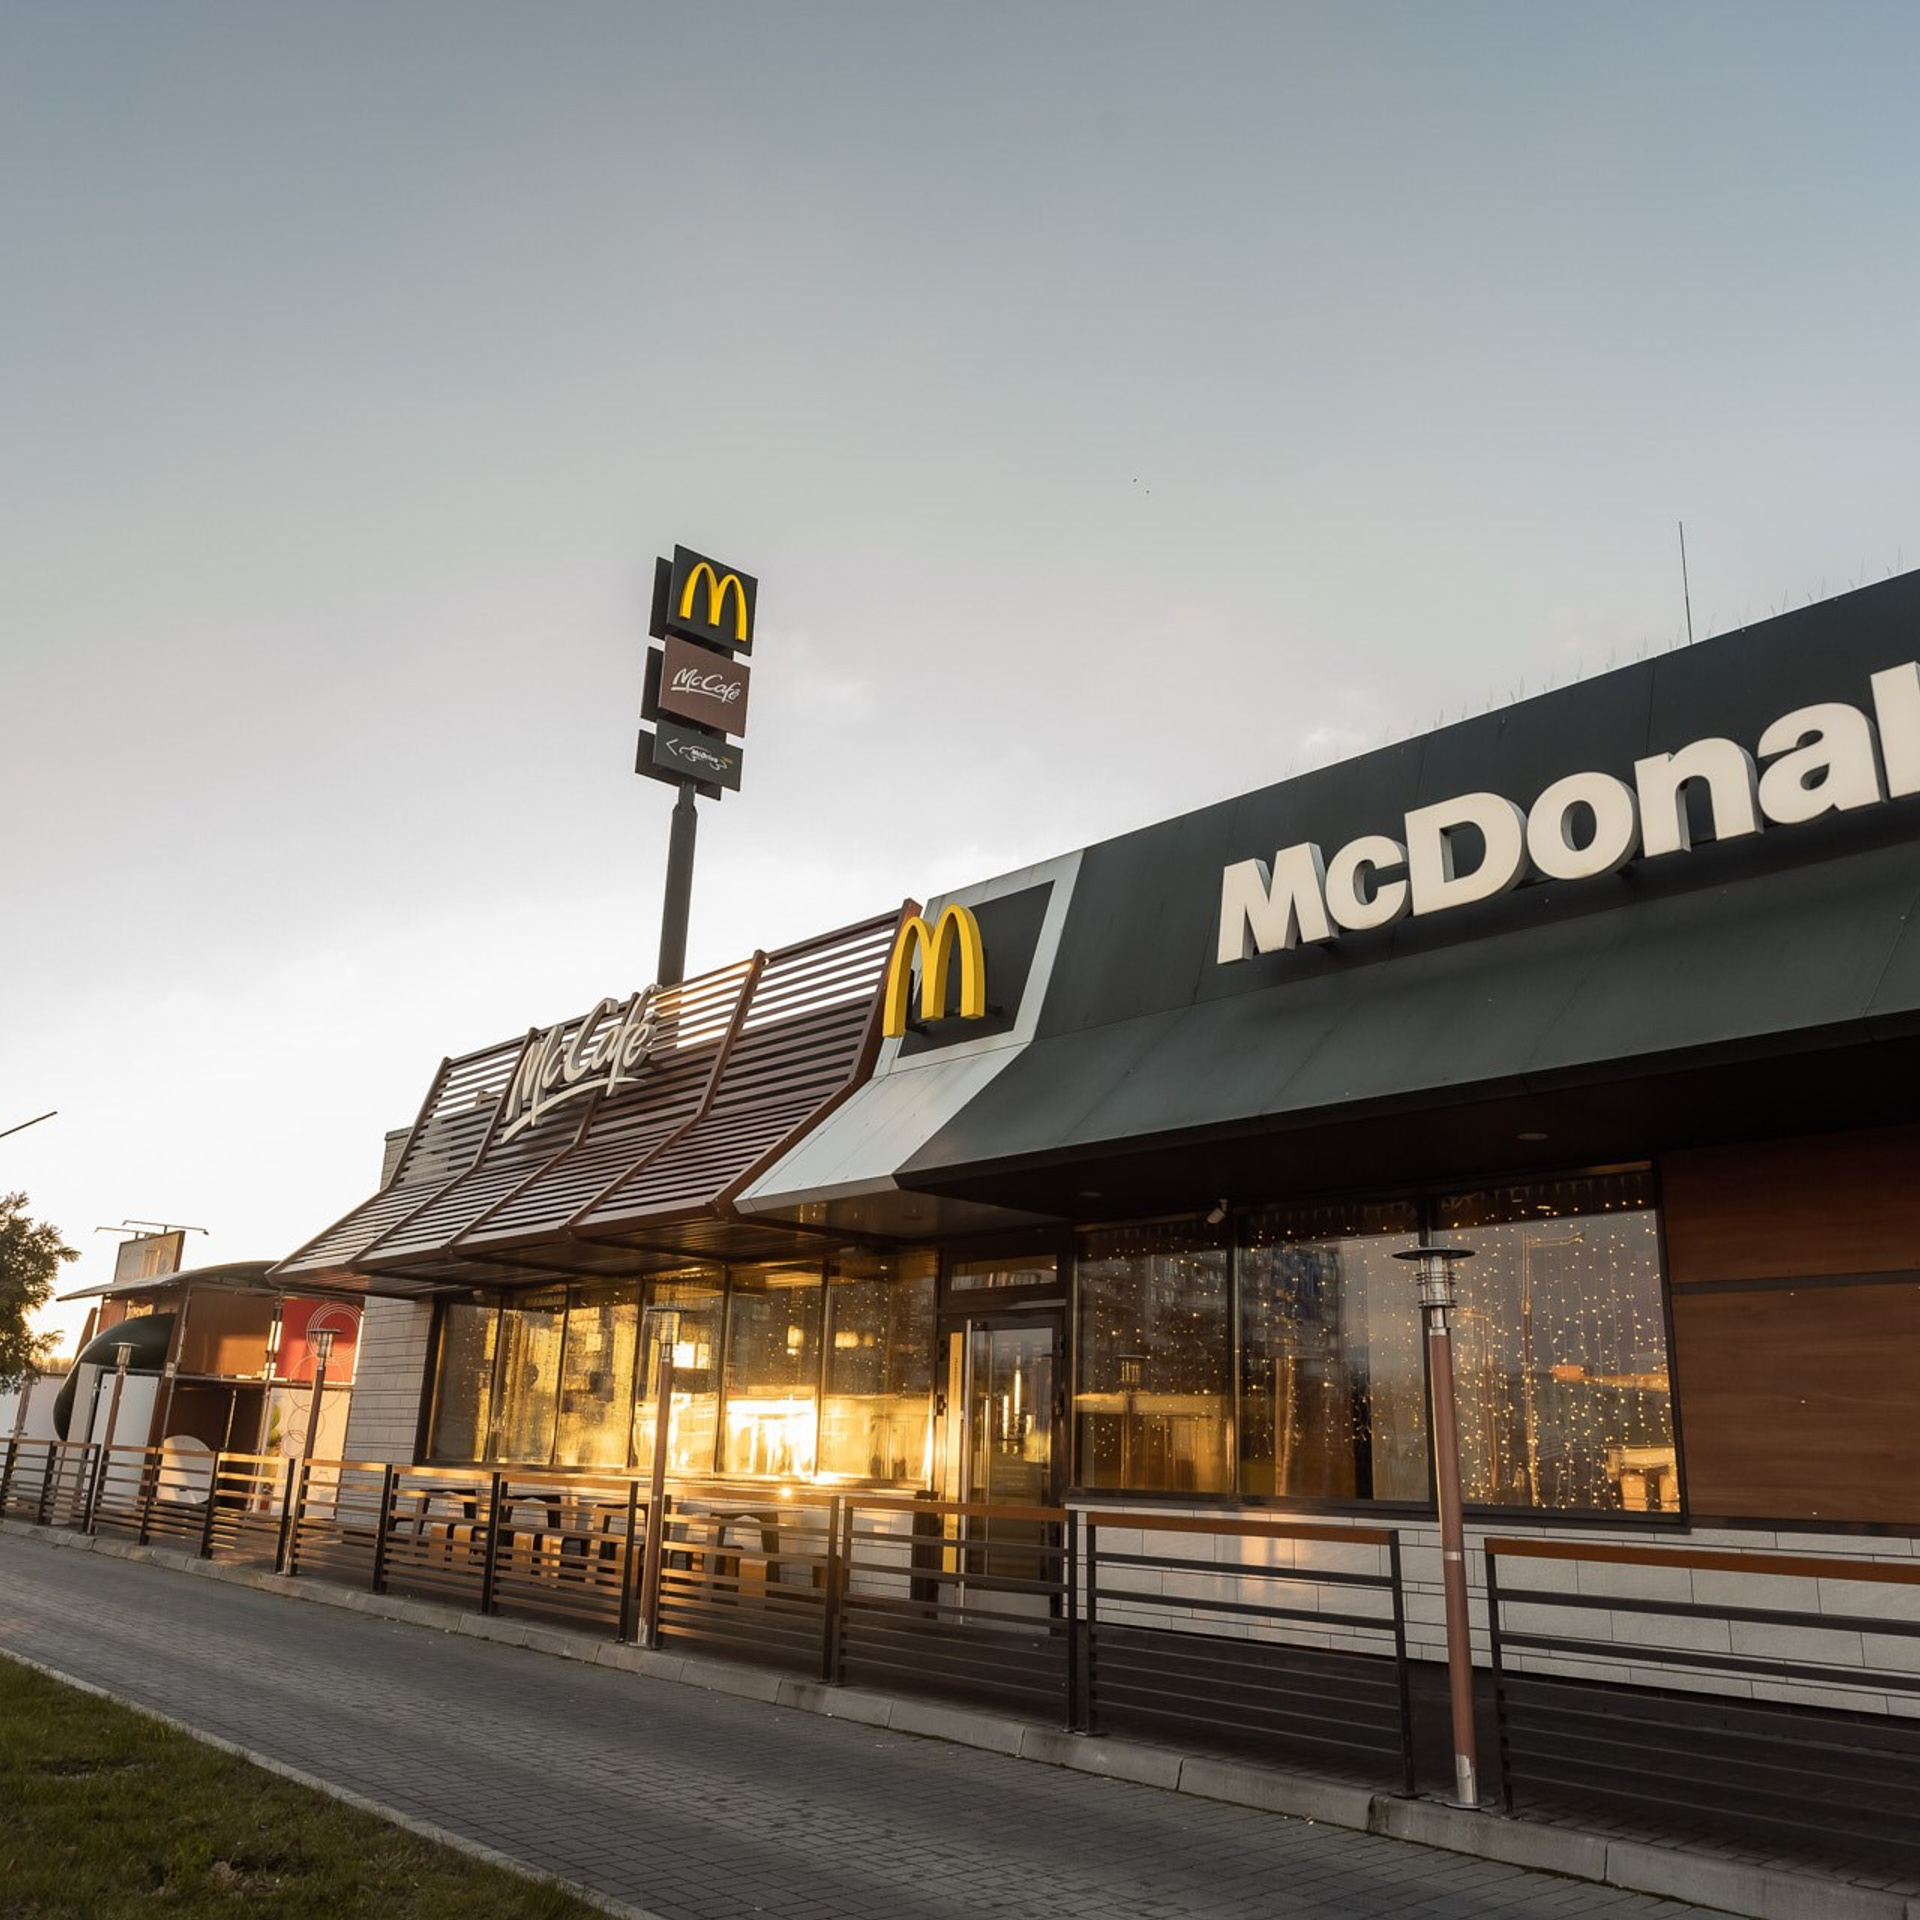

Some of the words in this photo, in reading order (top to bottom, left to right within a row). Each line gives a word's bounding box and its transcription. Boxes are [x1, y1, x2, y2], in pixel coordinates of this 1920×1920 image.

[671, 667, 741, 703] McCafé
[1217, 661, 1920, 964] McDonal
[502, 983, 661, 1140] McCafé
